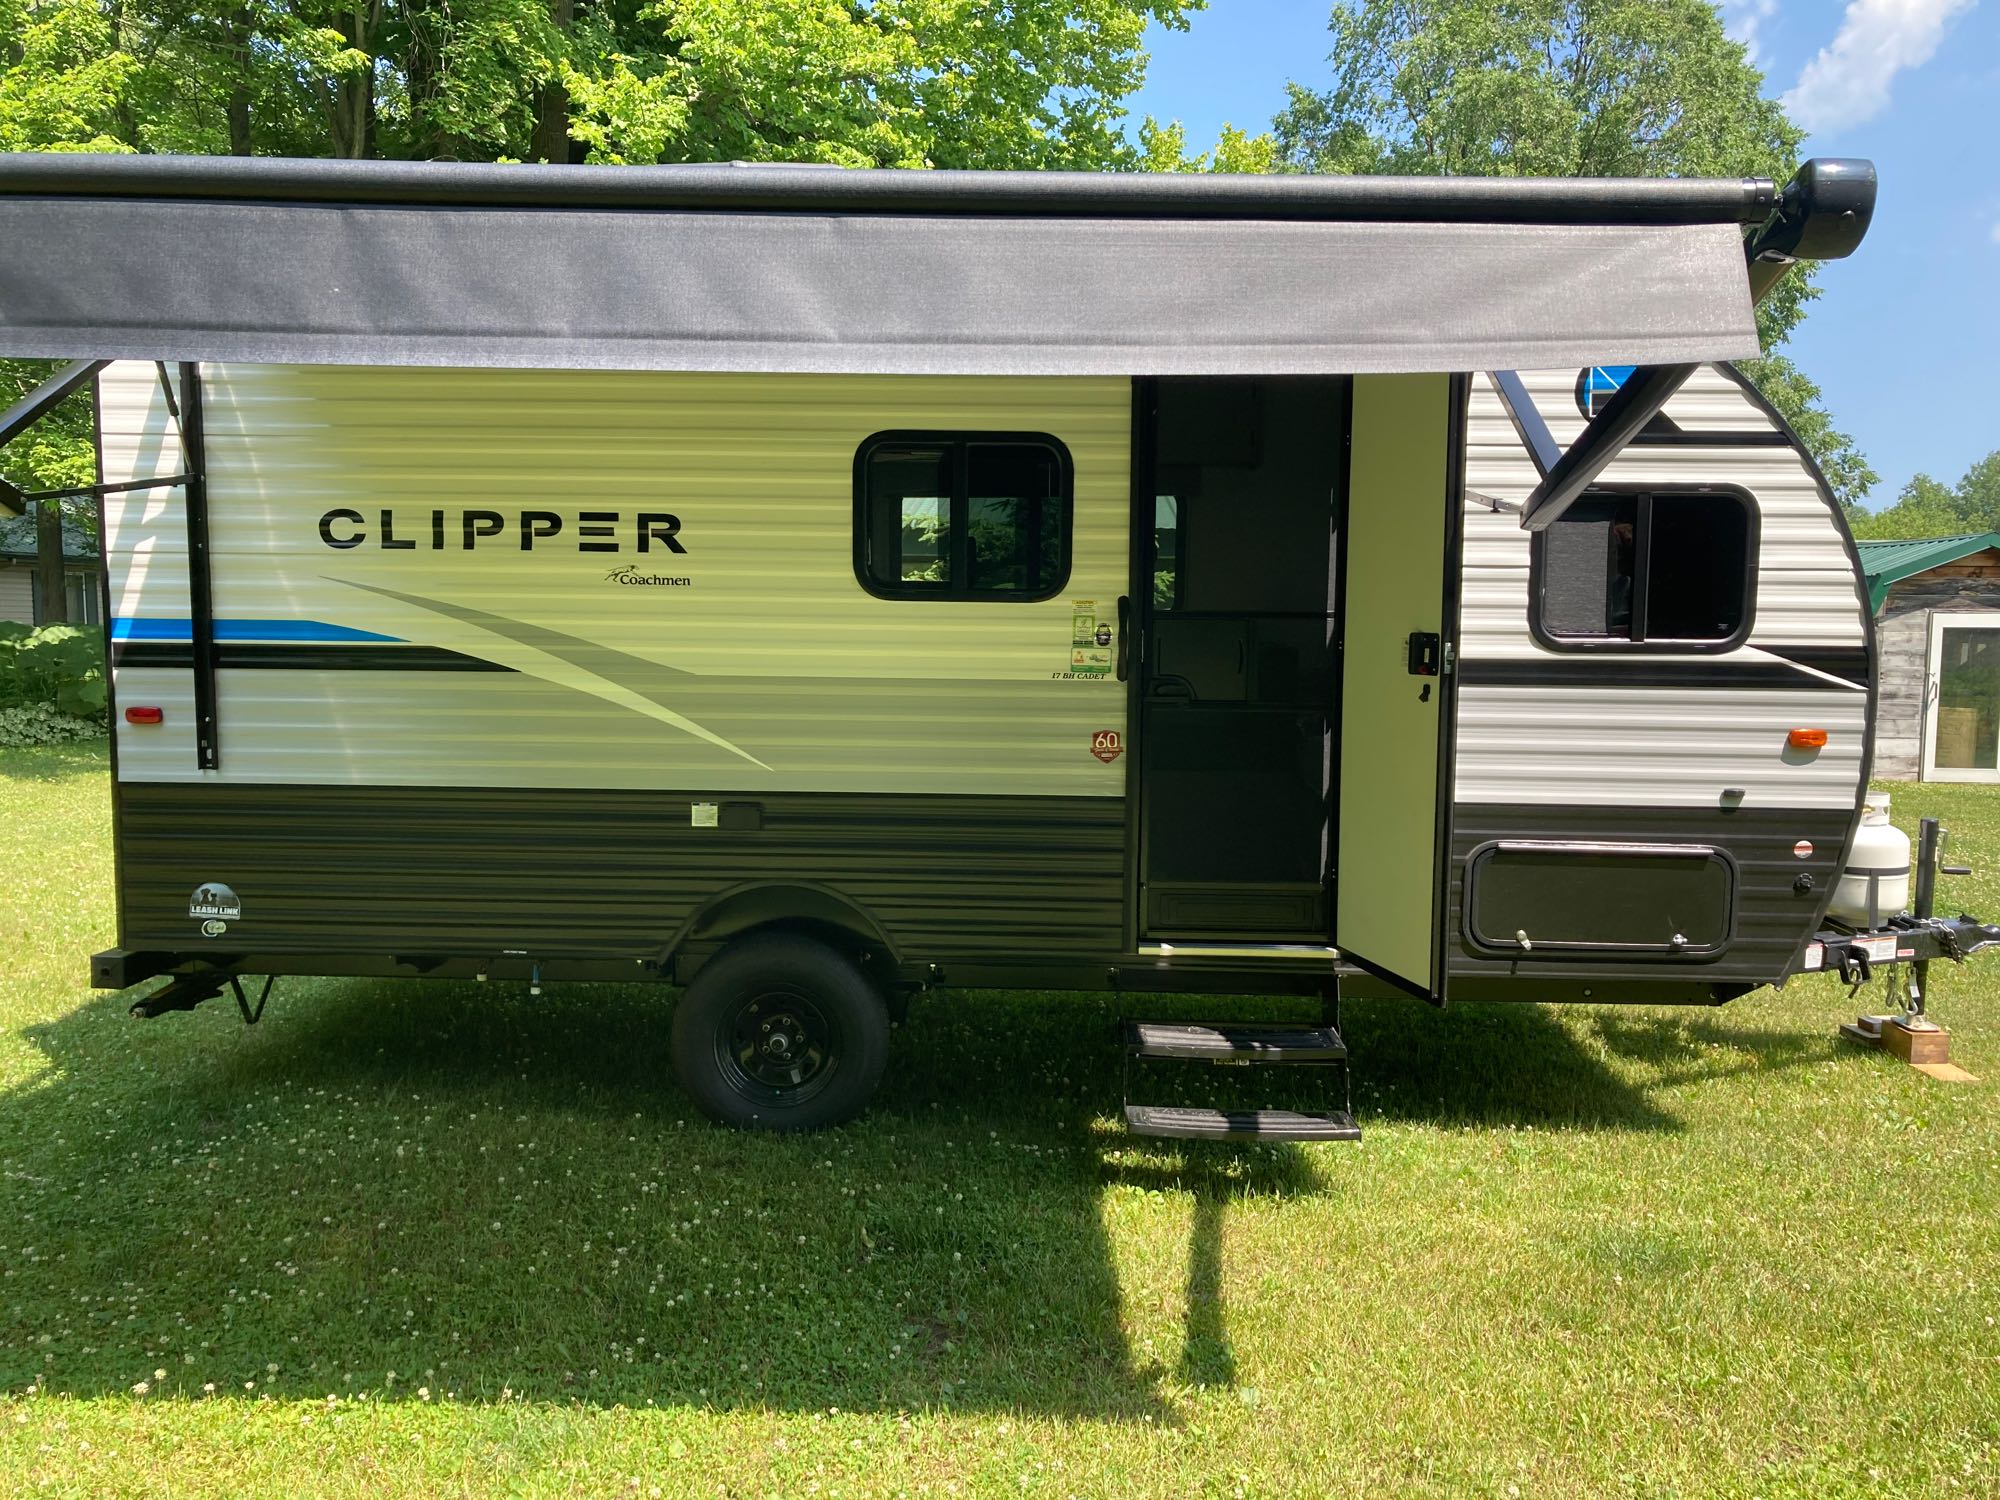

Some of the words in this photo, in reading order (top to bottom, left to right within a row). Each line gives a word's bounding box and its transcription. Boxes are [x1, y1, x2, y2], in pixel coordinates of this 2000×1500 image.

[318, 508, 688, 554] CLIPPER
[620, 574, 691, 586] Coachmen
[1062, 672, 1075, 680] BH
[1095, 732, 1118, 748] 60
[191, 905, 218, 914] LEASH
[219, 907, 239, 915] LINK
